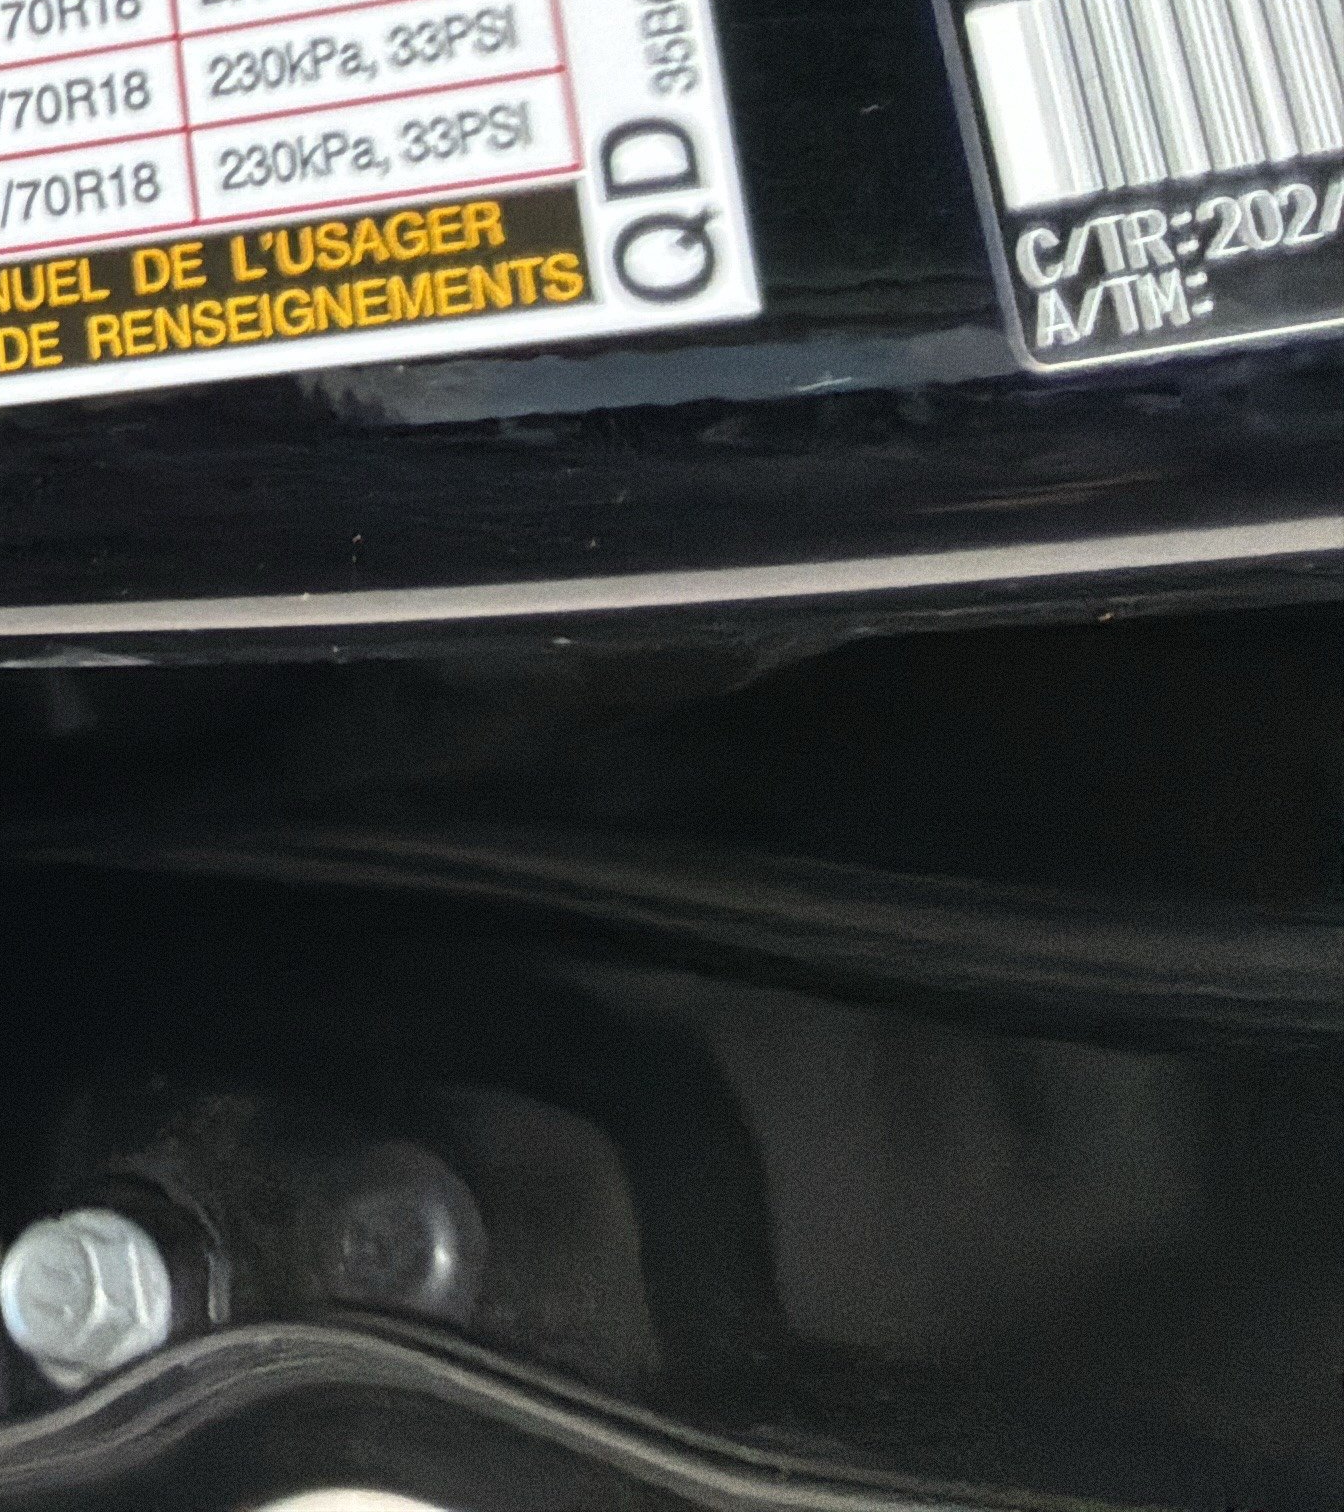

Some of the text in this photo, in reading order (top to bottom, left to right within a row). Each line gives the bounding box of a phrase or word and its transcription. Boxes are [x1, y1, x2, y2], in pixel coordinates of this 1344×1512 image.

[131, 240, 208, 297] DE
[229, 199, 506, 283] L'USAGER
[597, 115, 718, 305] QD
[85, 250, 585, 360] RENSEIGNEMENTS
[1035, 267, 1215, 349] A/TM:
